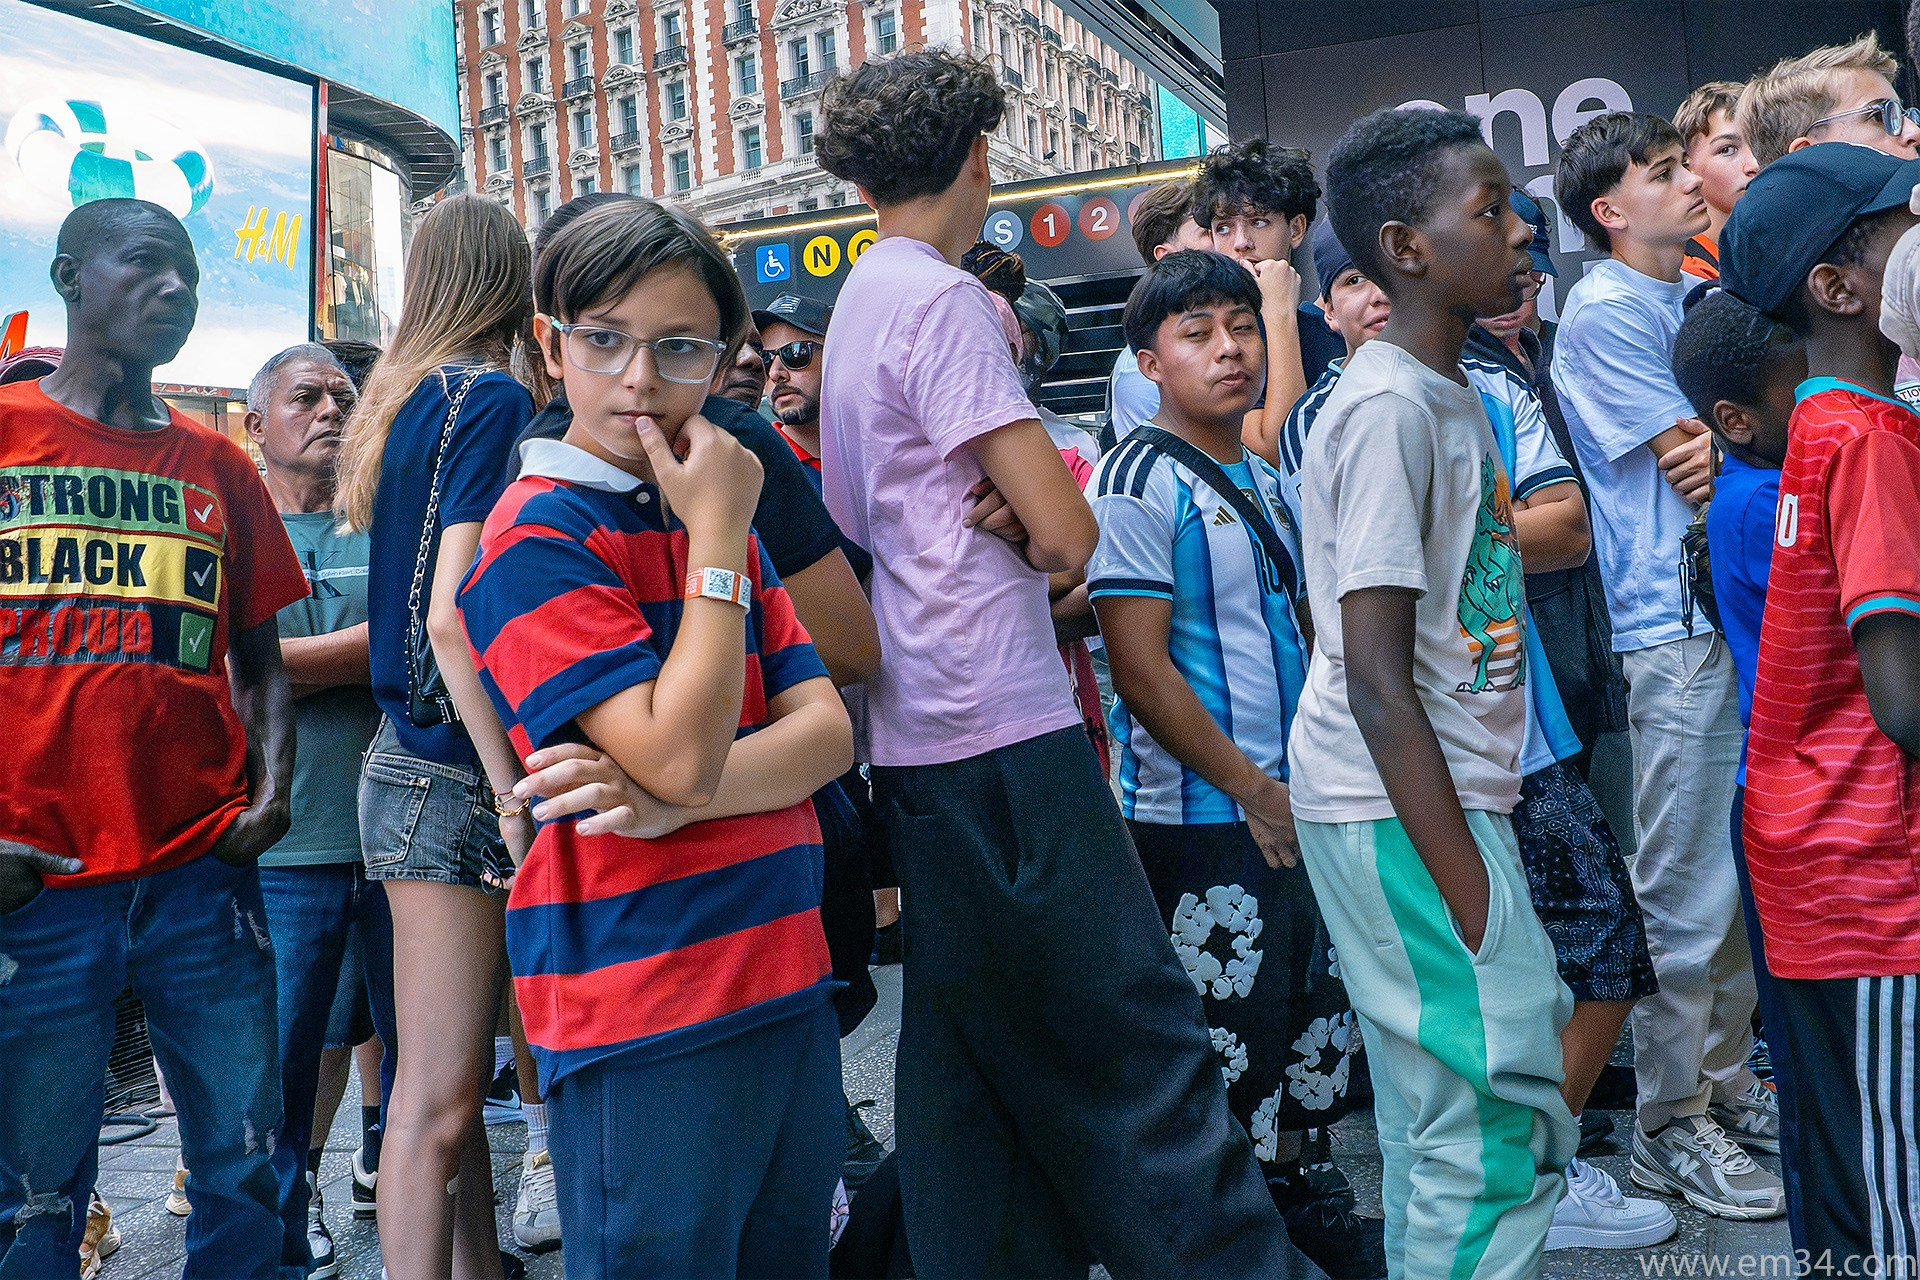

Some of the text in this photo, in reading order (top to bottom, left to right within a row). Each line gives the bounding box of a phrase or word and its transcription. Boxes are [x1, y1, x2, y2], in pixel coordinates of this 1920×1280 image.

[1393, 77, 1634, 167] ne
[234, 205, 302, 270] H&M
[813, 244, 831, 268] N
[994, 219, 1014, 245] S
[1043, 213, 1056, 238] 1
[1091, 206, 1109, 232] 2
[0, 537, 147, 587] BLACK
